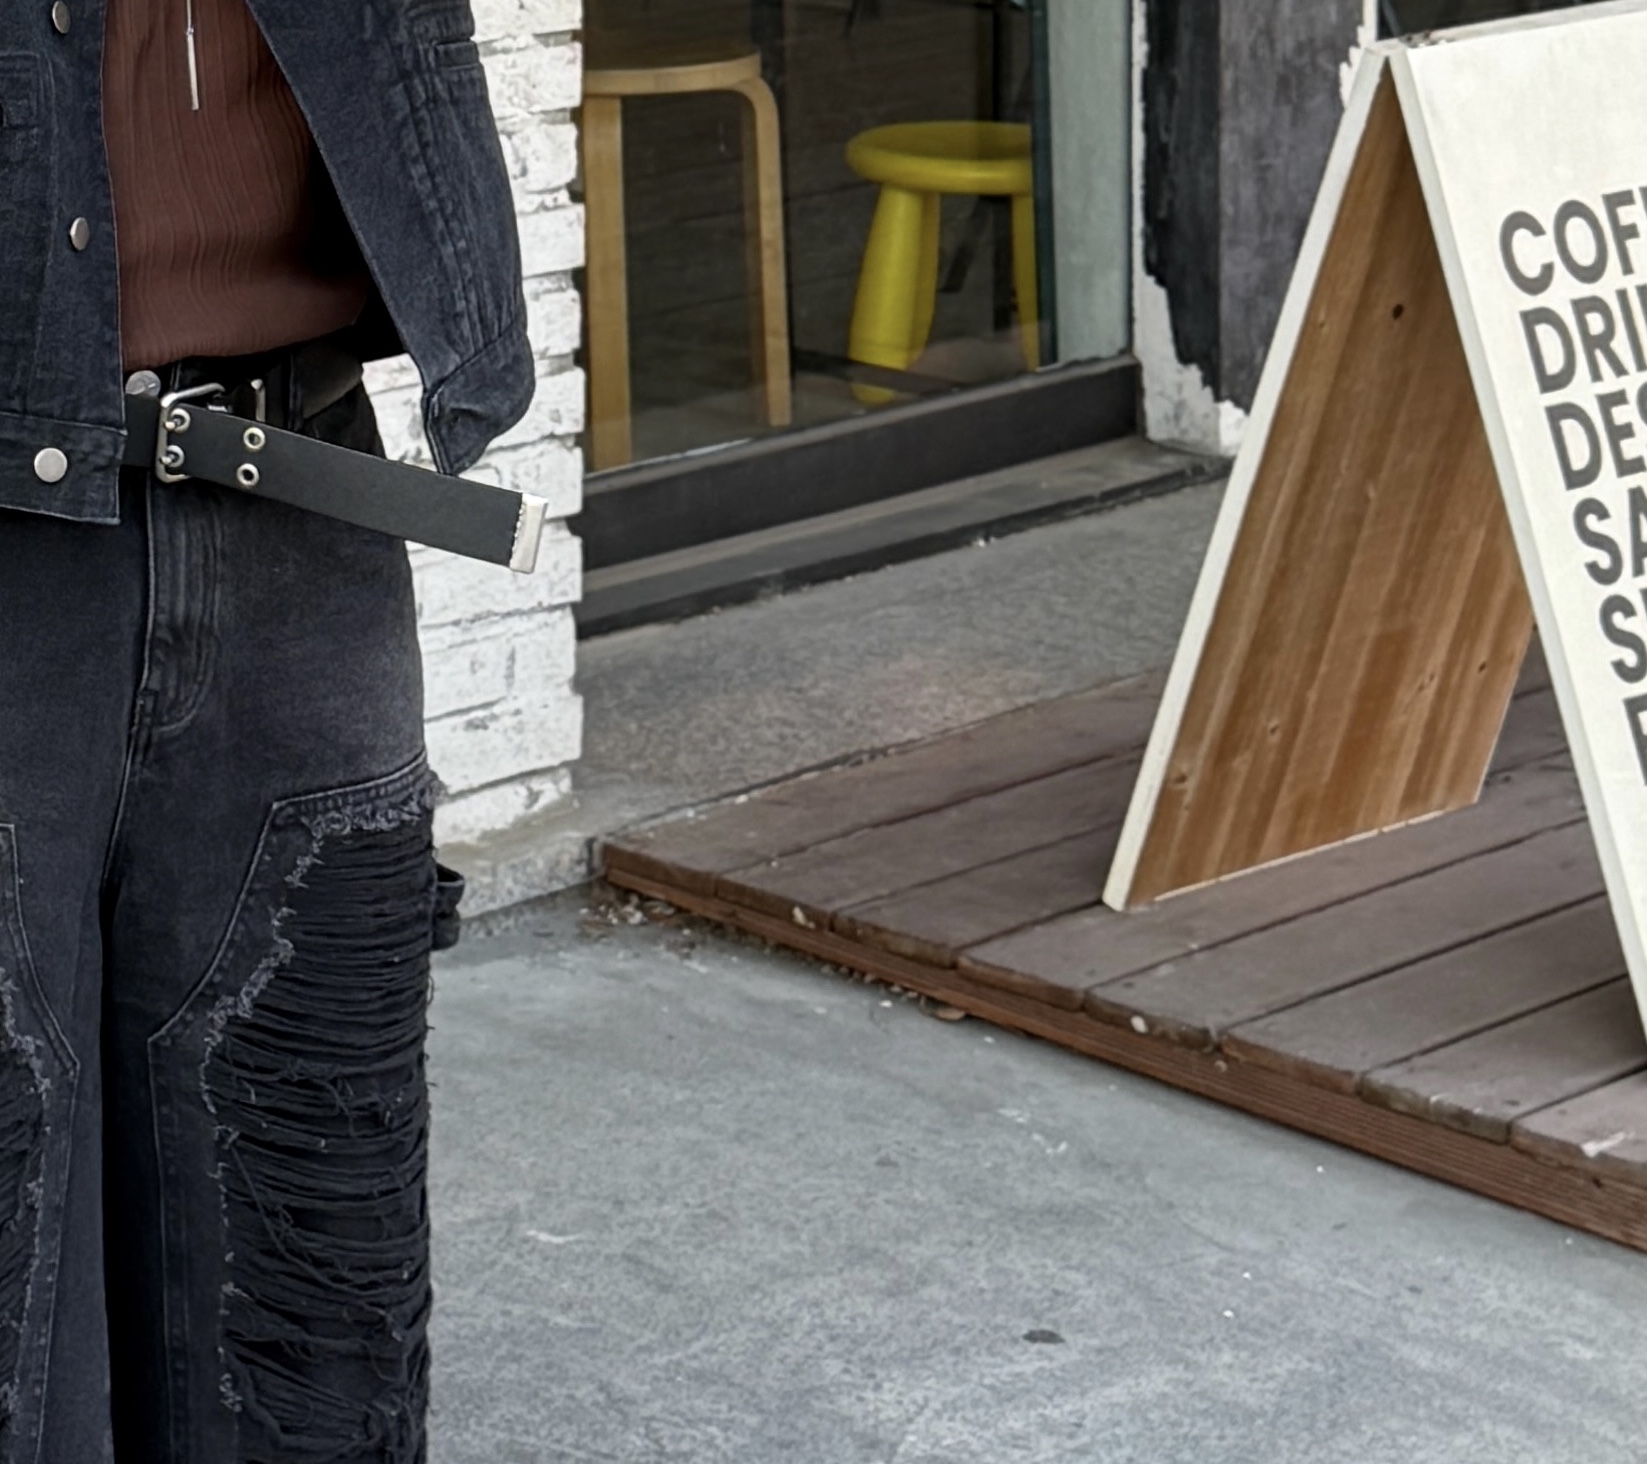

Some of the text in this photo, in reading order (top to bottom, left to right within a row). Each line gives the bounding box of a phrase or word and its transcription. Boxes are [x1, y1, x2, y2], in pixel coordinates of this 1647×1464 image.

[1498, 185, 1647, 297] COF
[1519, 283, 1647, 395] DRI
[1544, 381, 1647, 491] DE
